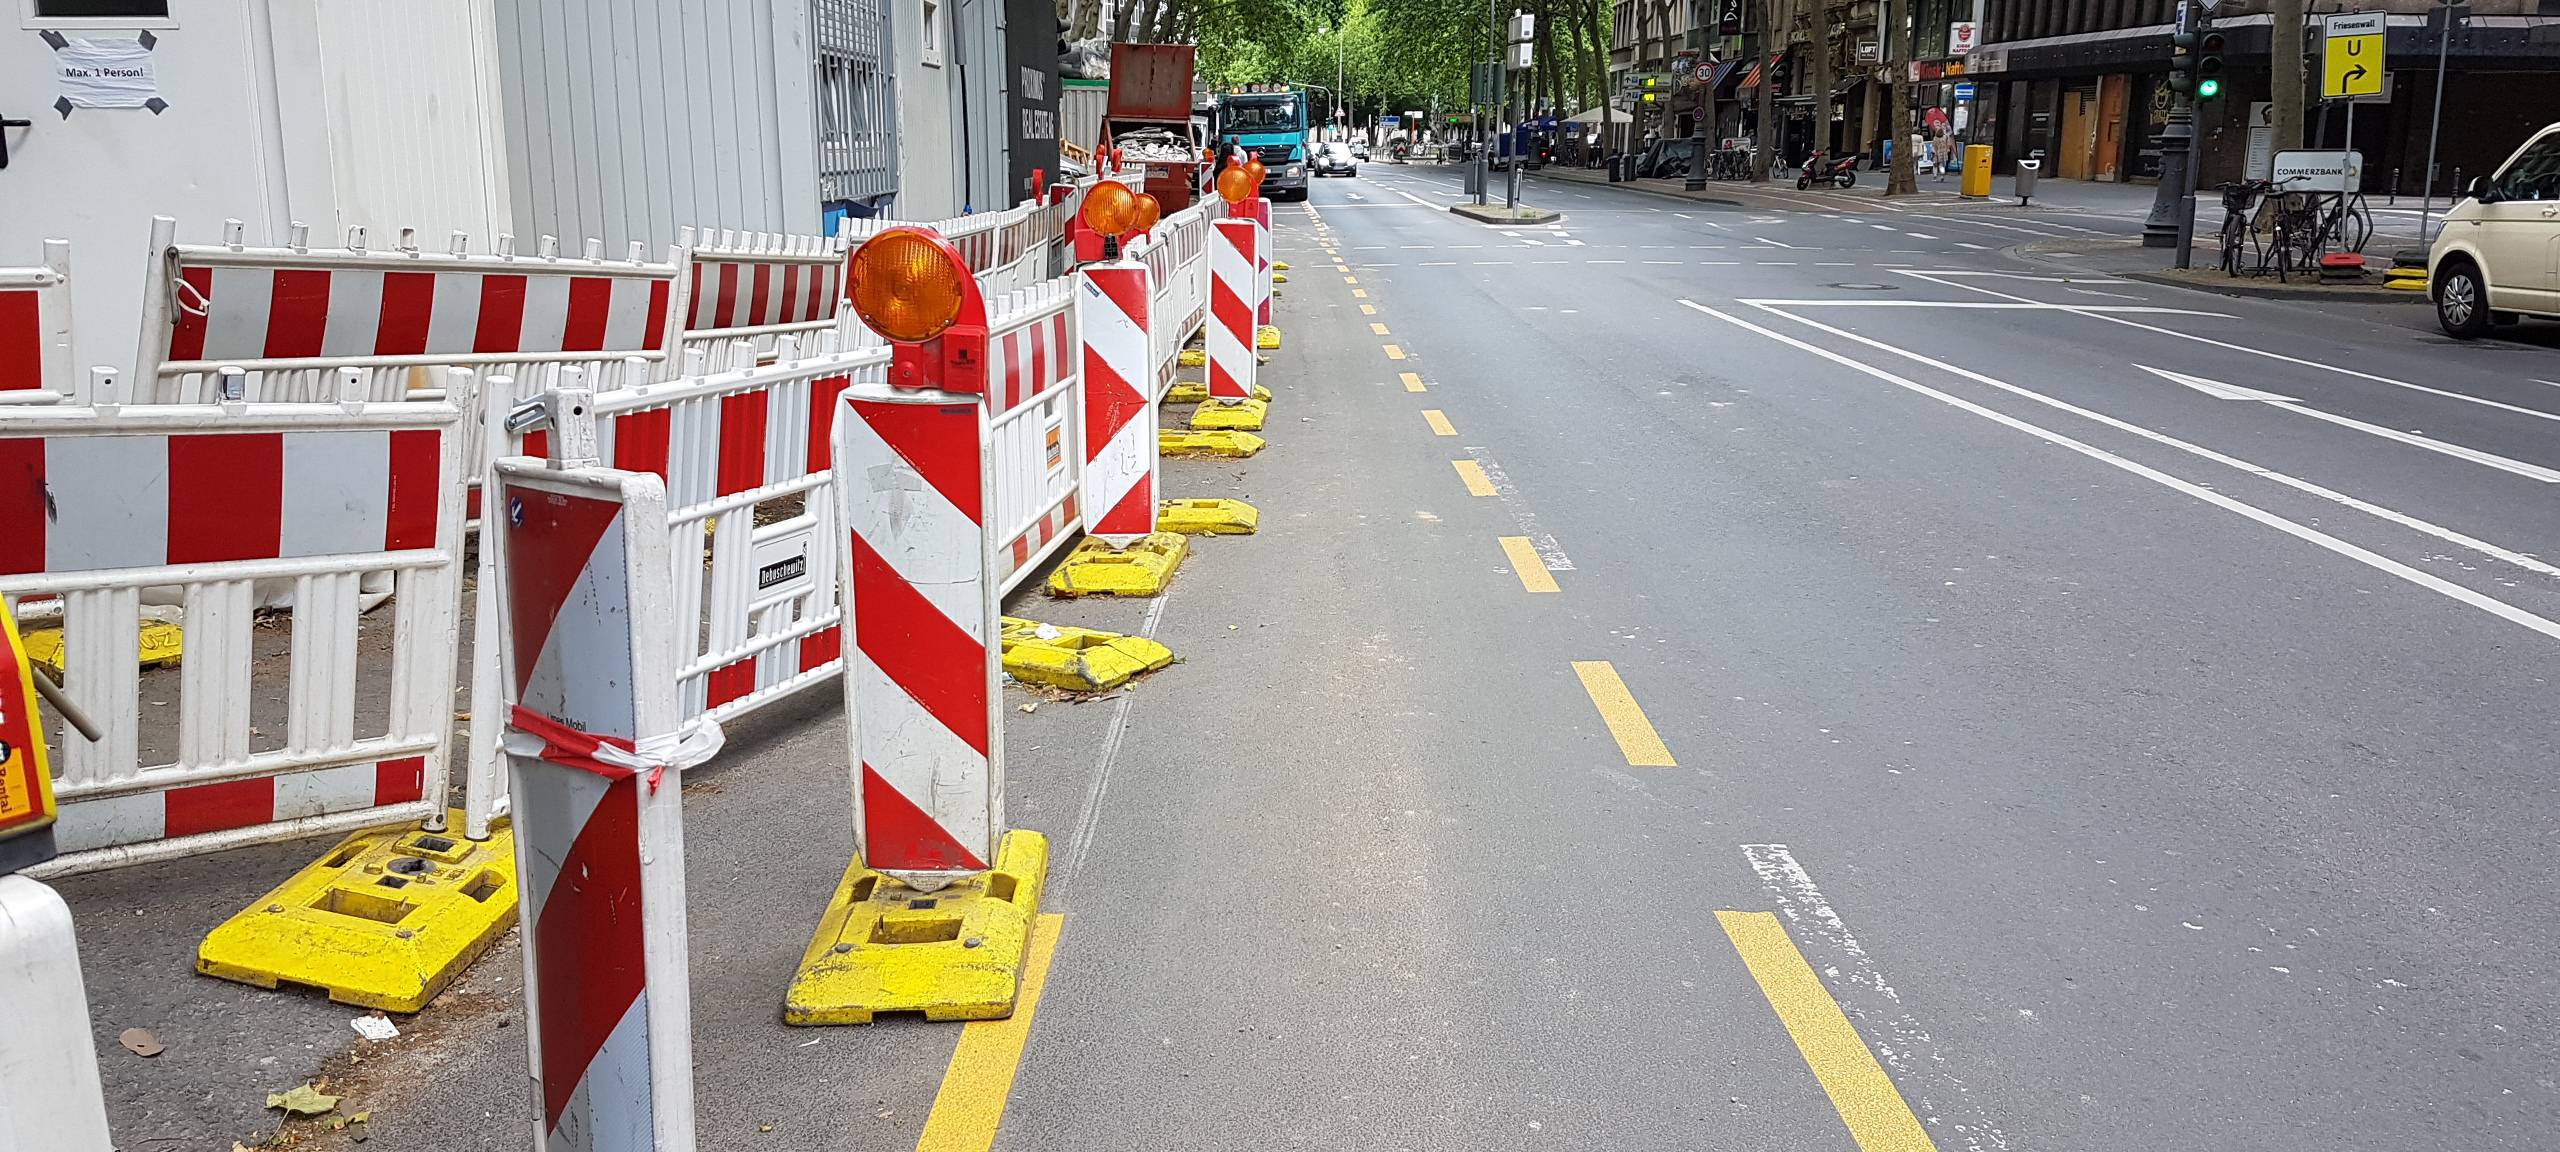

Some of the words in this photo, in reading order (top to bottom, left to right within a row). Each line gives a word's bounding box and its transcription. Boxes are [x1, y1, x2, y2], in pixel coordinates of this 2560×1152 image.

[2333, 19, 2375, 30] Friesenwall
[2347, 40, 2361, 56] U
[65, 68, 92, 77] Max.
[95, 68, 101, 77] 1
[103, 67, 144, 77] Person!
[1699, 68, 1711, 78] 30
[1022, 108, 1034, 139] REAL
[1034, 109, 1048, 139] ESTATE
[1048, 111, 1054, 139] AG
[2277, 168, 2343, 176] COMMERZBANK
